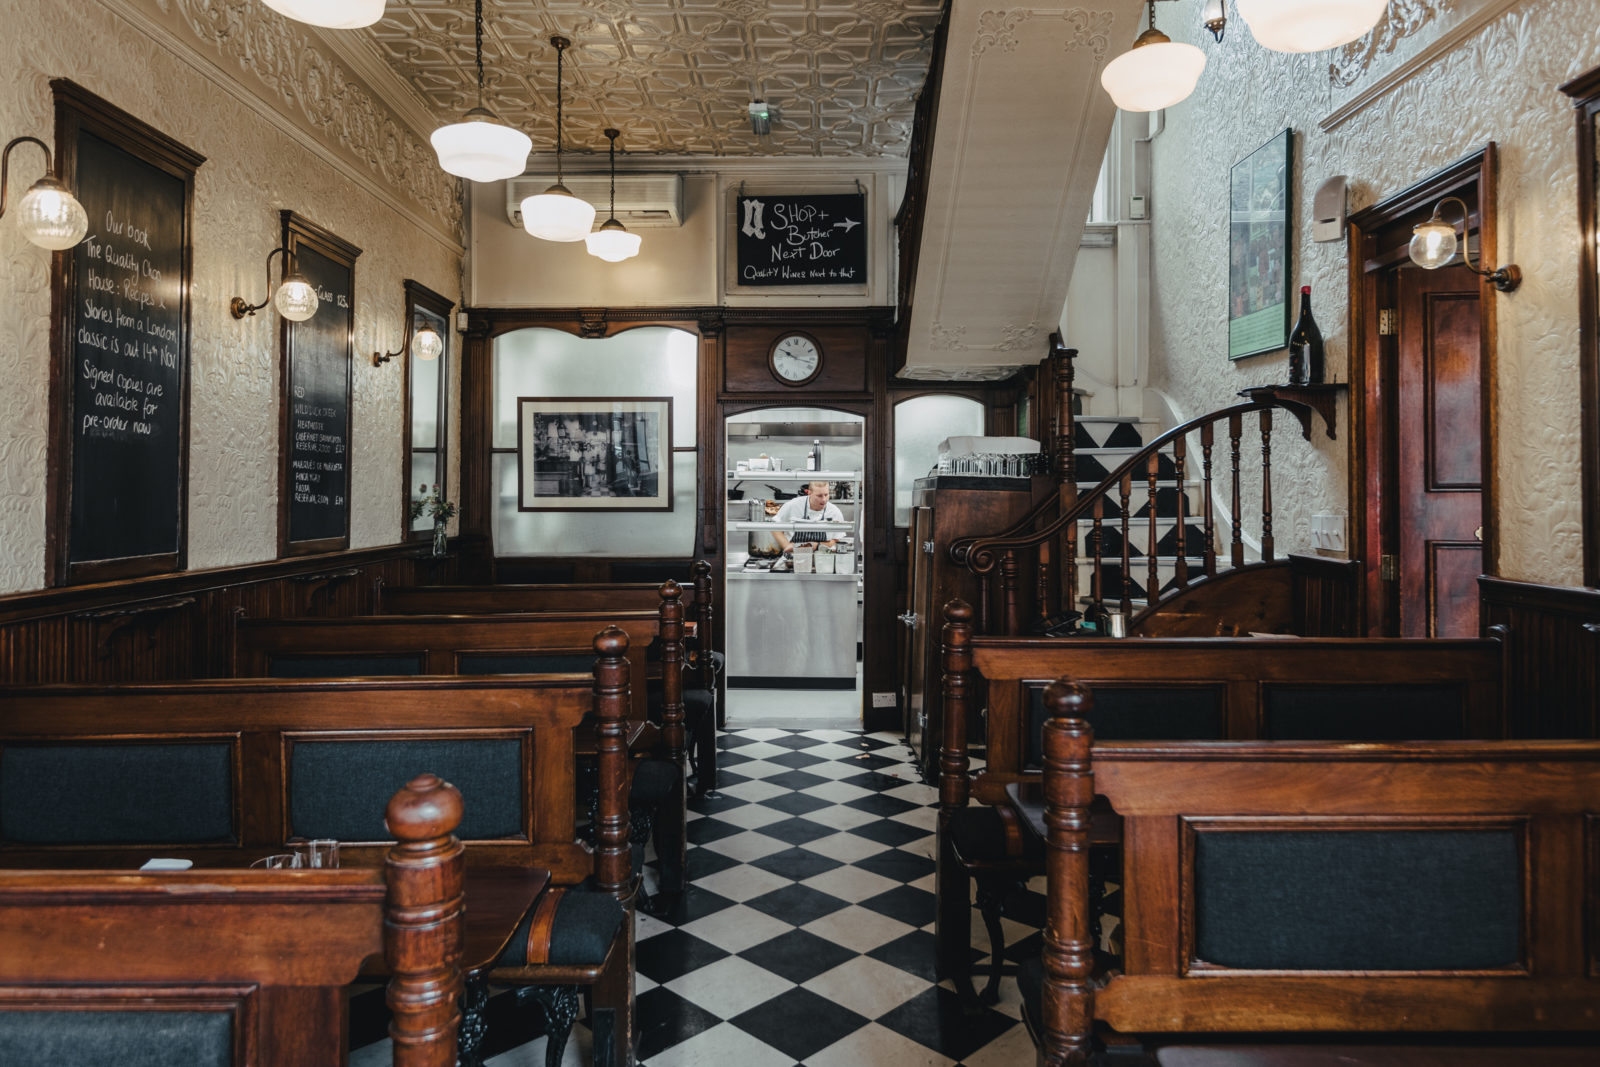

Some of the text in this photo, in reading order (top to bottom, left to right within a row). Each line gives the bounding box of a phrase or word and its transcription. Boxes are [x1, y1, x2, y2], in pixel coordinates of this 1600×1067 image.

[106, 210, 152, 251] Our book
[787, 225, 834, 246] Butcher
[82, 235, 102, 259] The
[105, 244, 139, 286] Quality
[809, 241, 841, 260] Door
[84, 299, 177, 345] Stories from a London
[110, 336, 120, 355] is
[123, 340, 140, 359] out
[160, 345, 177, 370] Nov
[83, 359, 115, 391] Signed
[146, 382, 164, 397] are
[294, 384, 305, 399] RED
[95, 391, 159, 420] available for
[82, 414, 152, 435] pre-order now
